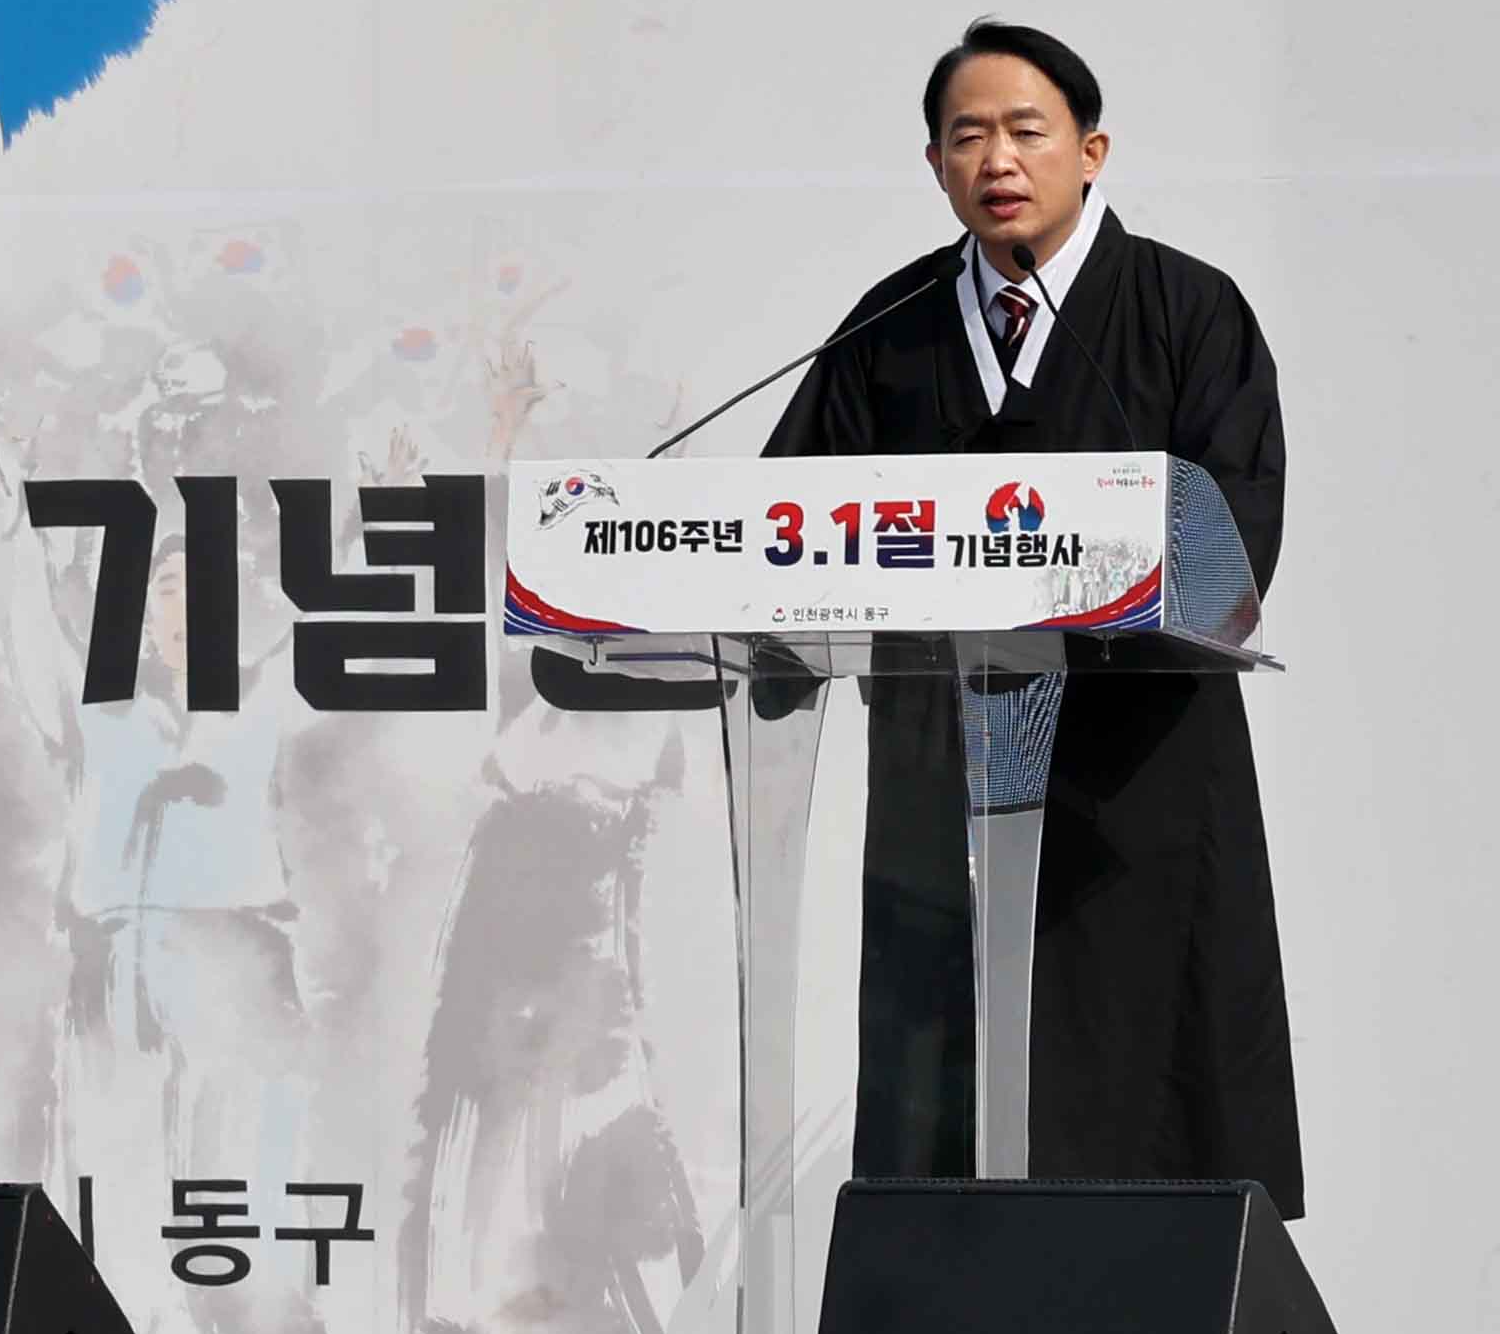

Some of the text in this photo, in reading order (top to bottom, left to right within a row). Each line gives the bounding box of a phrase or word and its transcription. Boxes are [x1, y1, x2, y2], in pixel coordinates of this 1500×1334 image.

[583, 499, 1084, 569] 제106주년 3.1절 기념행사
[864, 607, 890, 622] 동구
[160, 1178, 376, 1288] 동구
